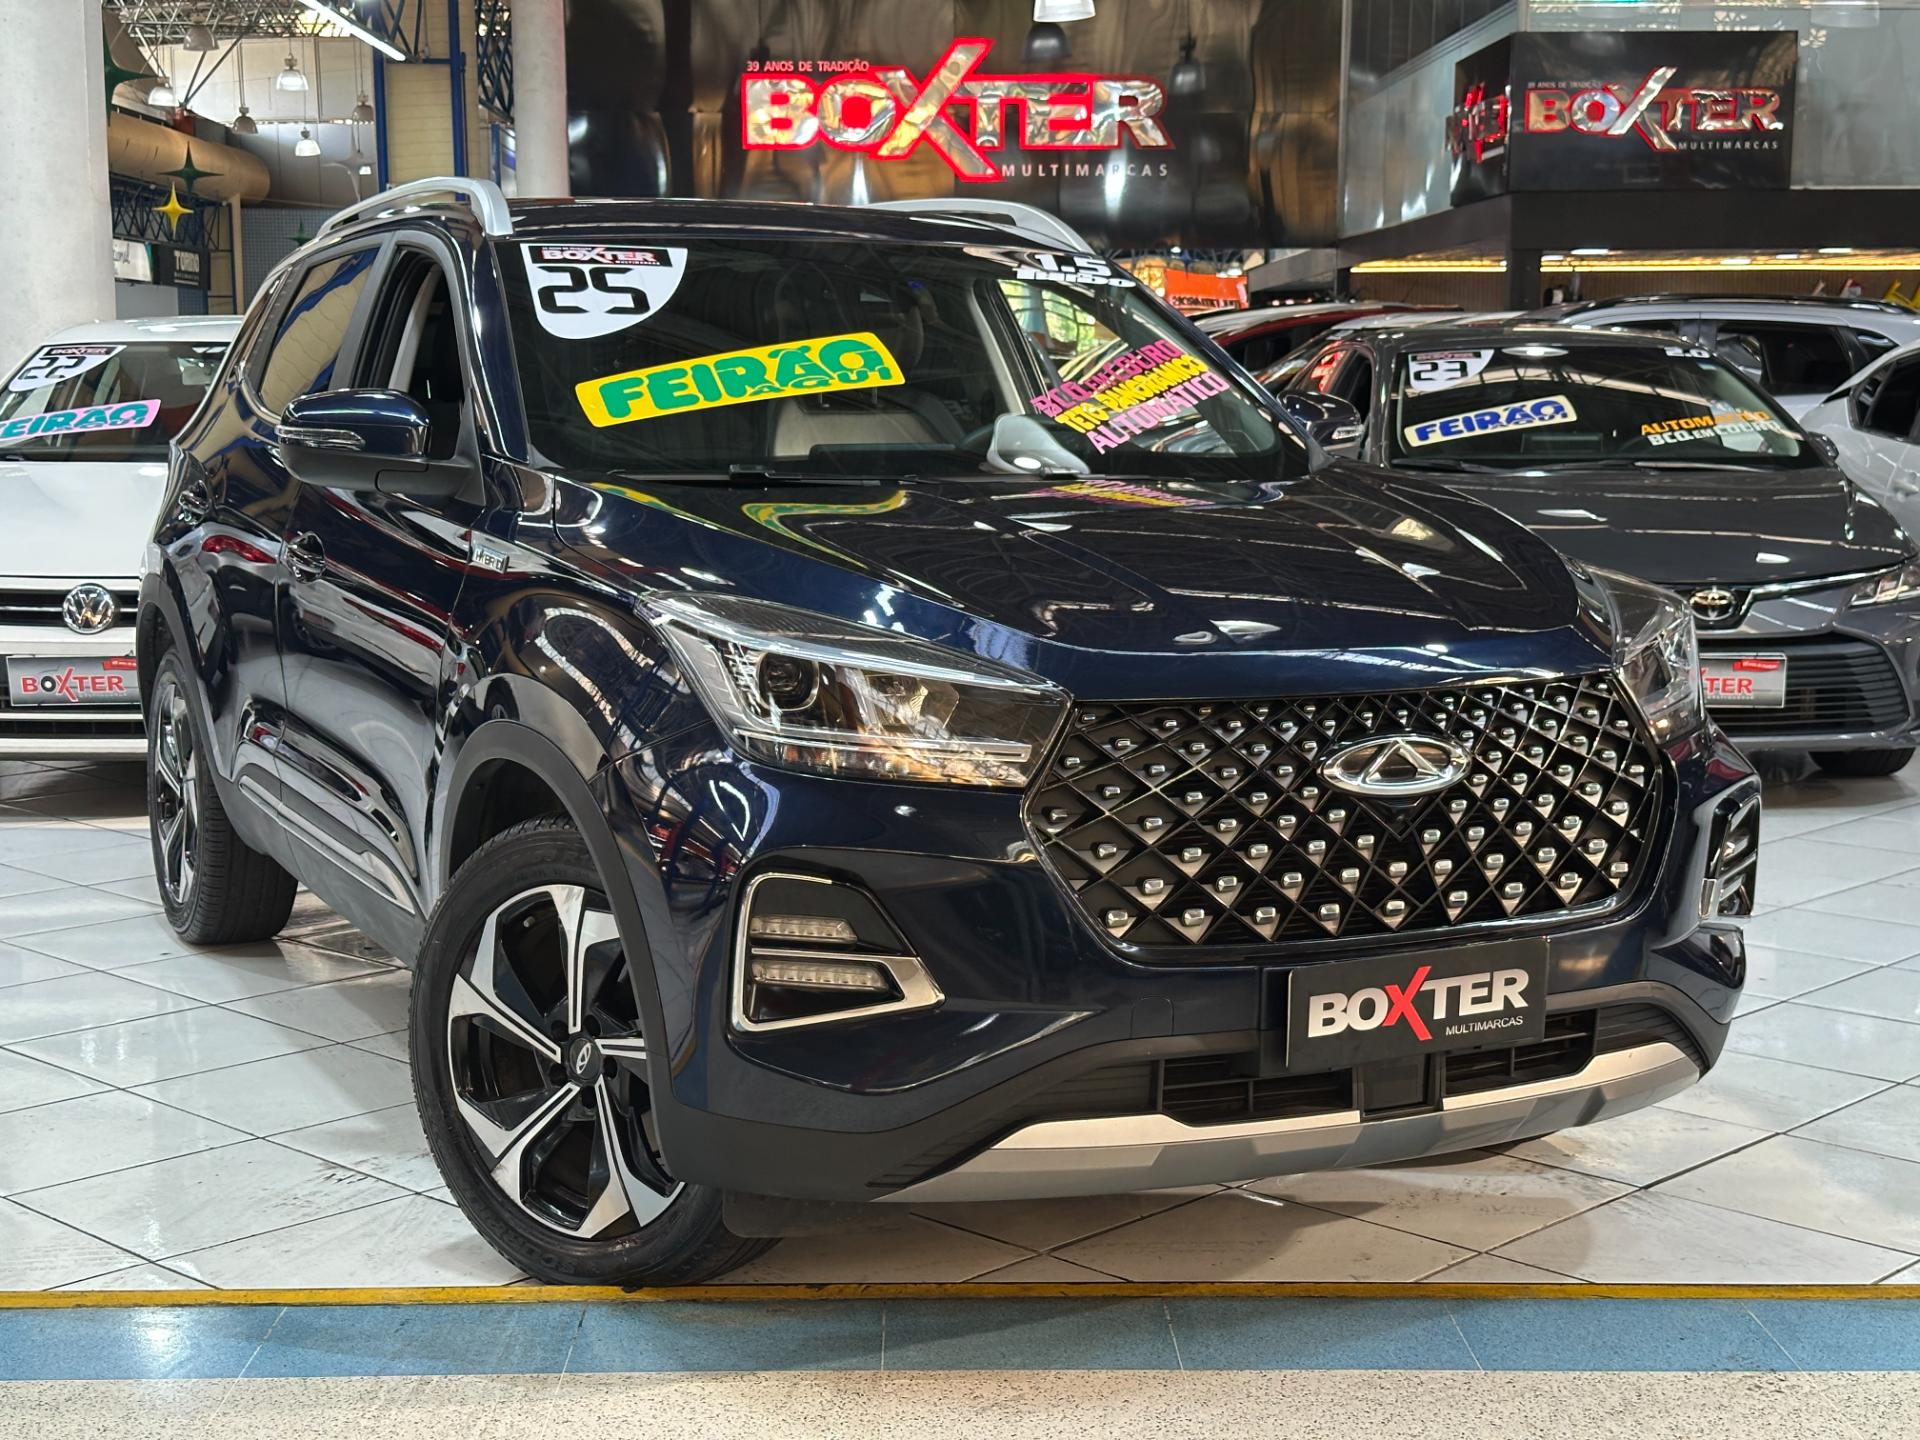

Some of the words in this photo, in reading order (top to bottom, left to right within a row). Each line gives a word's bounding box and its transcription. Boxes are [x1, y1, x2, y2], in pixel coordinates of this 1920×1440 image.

[746, 61, 760, 72] 39
[764, 61, 794, 72] ANOS
[798, 61, 812, 72] DE
[817, 59, 869, 74] TRADIÇÃO
[742, 38, 1175, 181] BOXTER
[1525, 66, 1784, 151] BOXTER
[1678, 140, 1780, 150] MULTIMARCAS
[1002, 164, 1169, 177] MULTIMARCAS
[540, 247, 658, 264] BOXTER
[1034, 253, 1112, 277] 1.5
[536, 265, 651, 315] 25
[51, 347, 107, 355] BOXTER
[1664, 346, 1710, 358] 2.0
[18, 356, 86, 380] 22
[598, 339, 886, 419] FEIRÃO
[1413, 361, 1468, 381] 23
[0, 403, 149, 438] EIRÃO
[1055, 402, 1110, 434] TETO
[1415, 400, 1565, 441] FEIRÃO
[21, 667, 126, 702] BOXTER
[1702, 668, 1753, 696] TER
[1308, 966, 1529, 1041] BOXTER
[1446, 1015, 1523, 1036] MULTIMARCAS
